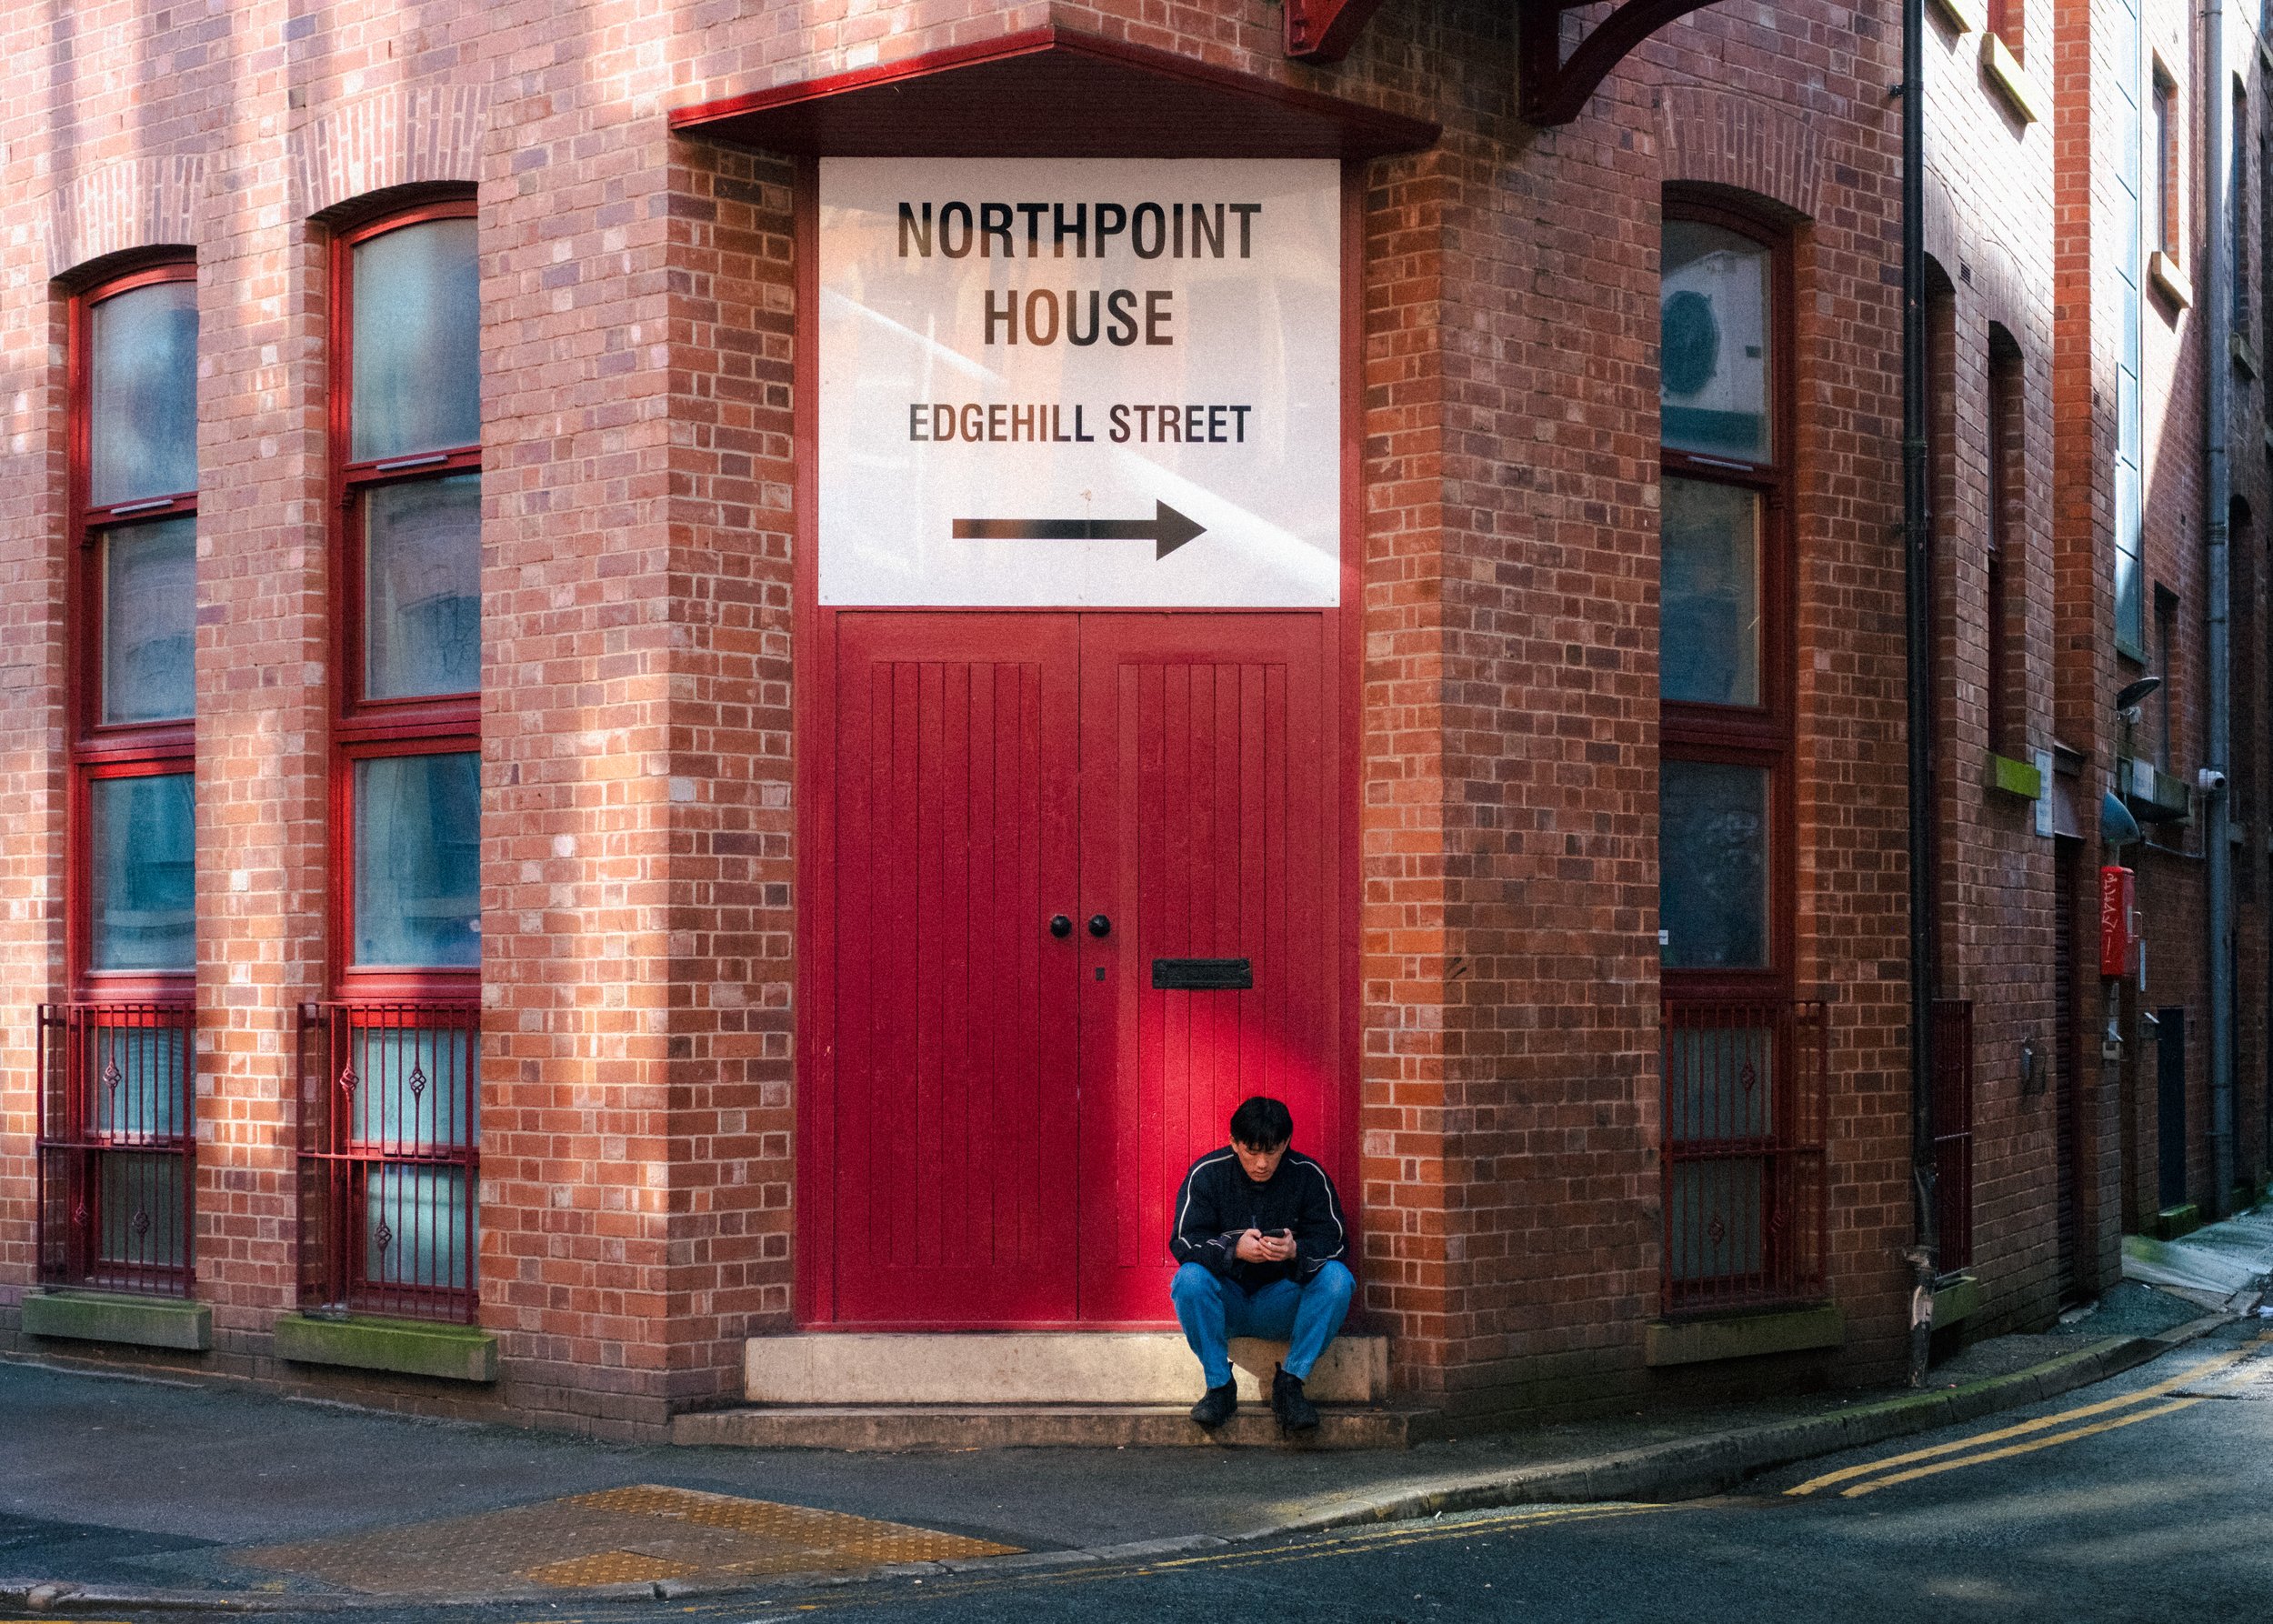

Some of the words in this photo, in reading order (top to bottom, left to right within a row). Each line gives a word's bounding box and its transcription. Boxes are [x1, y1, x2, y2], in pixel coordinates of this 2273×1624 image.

[897, 201, 1262, 259] NORTHPOINT
[985, 289, 1174, 346] HOUSE
[909, 404, 1095, 443] EDGEHILL
[1109, 404, 1252, 443] STREET
